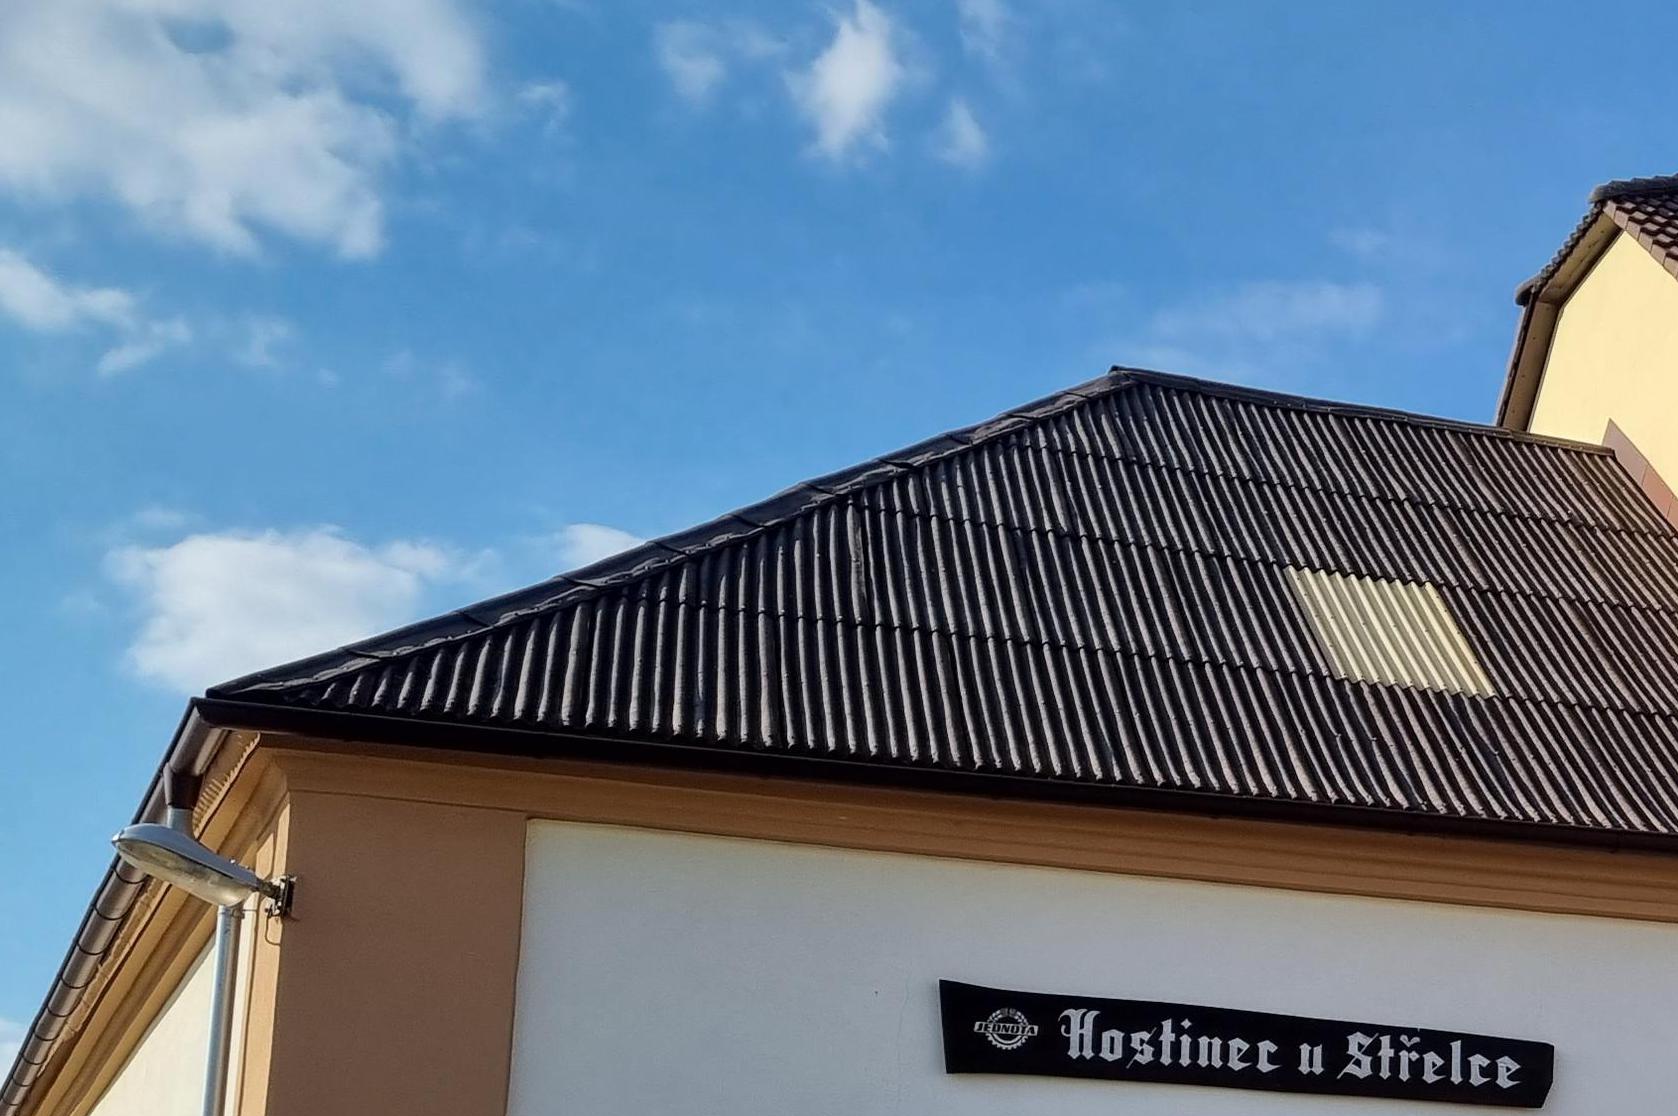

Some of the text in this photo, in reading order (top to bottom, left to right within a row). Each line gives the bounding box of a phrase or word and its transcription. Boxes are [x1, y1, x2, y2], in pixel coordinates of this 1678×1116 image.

[976, 1022, 1036, 1035] JEDNOTA
[1058, 1008, 1522, 1089] Hostinec u Střelce
